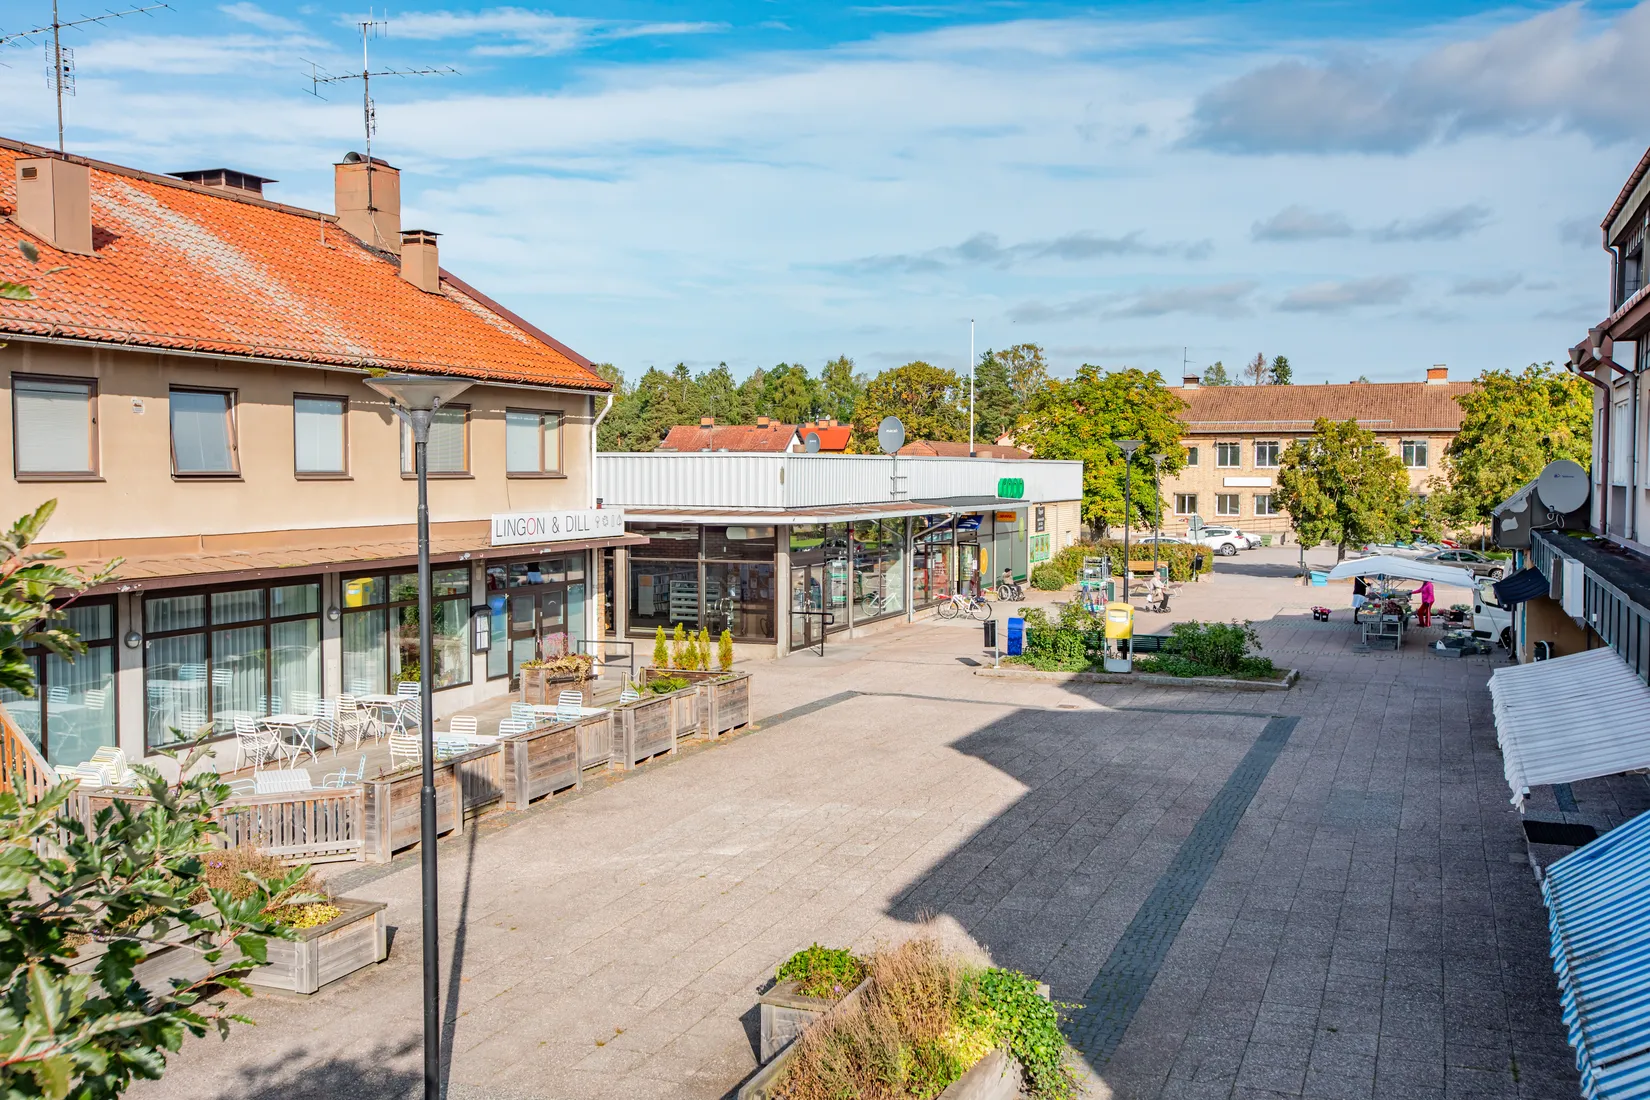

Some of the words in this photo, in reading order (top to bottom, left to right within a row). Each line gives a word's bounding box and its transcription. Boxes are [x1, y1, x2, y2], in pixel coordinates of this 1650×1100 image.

[496, 517, 545, 537] LINGON
[552, 516, 560, 534] &
[566, 515, 590, 532] DILL
